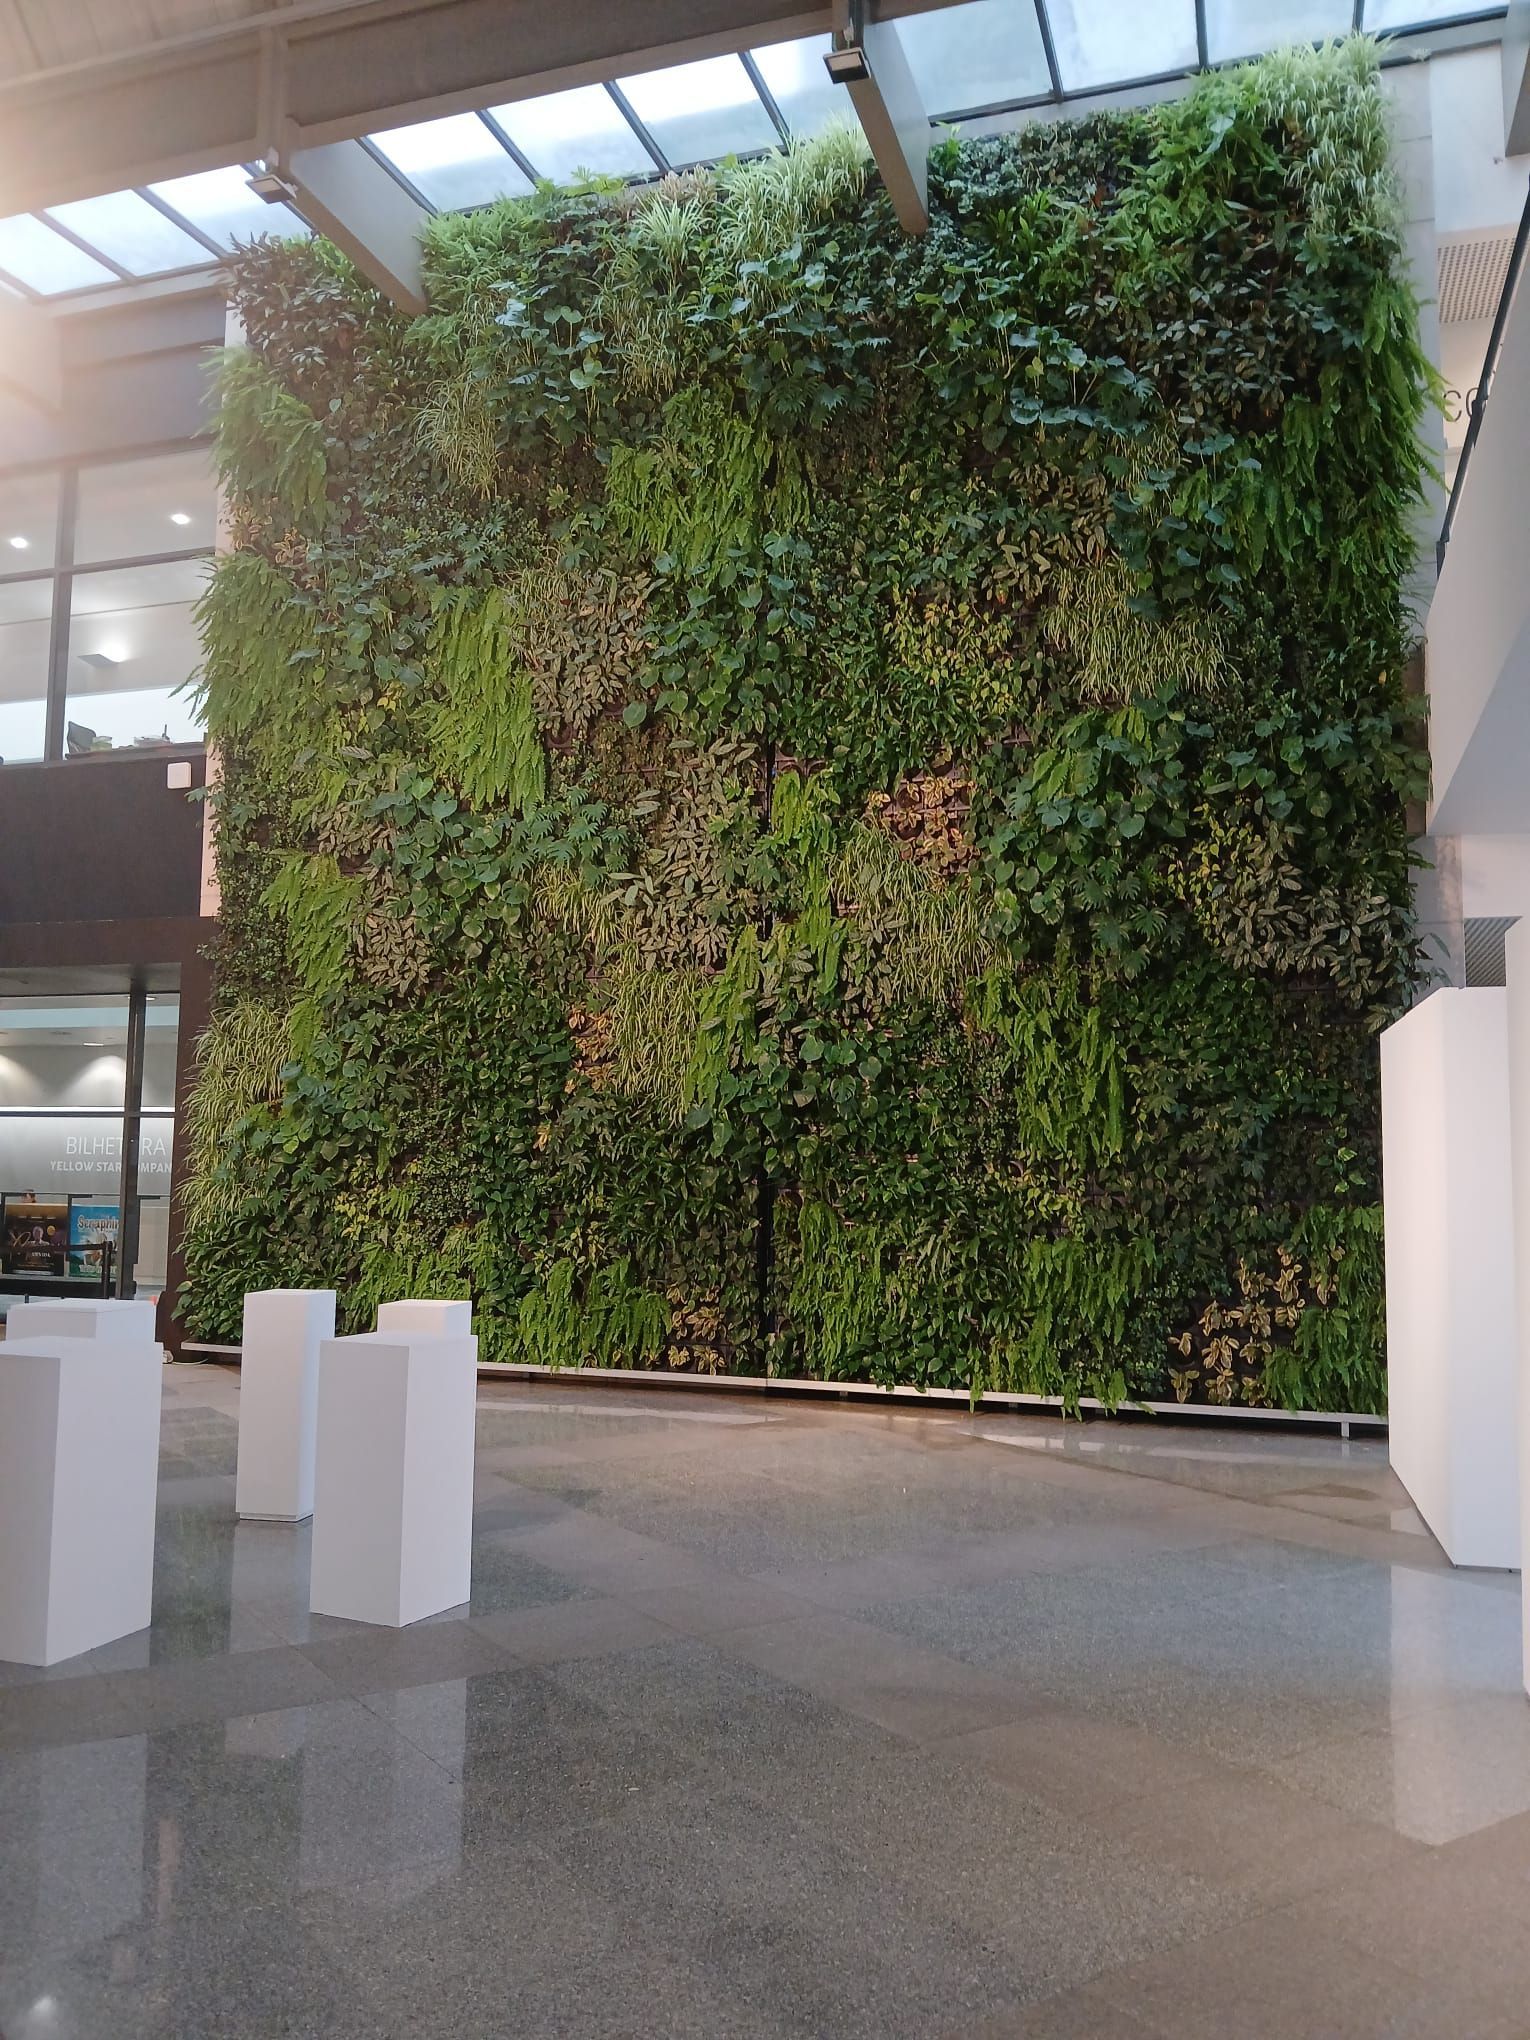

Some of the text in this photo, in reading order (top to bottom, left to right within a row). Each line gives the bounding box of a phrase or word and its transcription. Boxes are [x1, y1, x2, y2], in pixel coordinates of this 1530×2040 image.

[66, 1136, 166, 1155] BILHETRA
[50, 1160, 94, 1172] YELLOW
[96, 1161, 121, 1172] STAR
